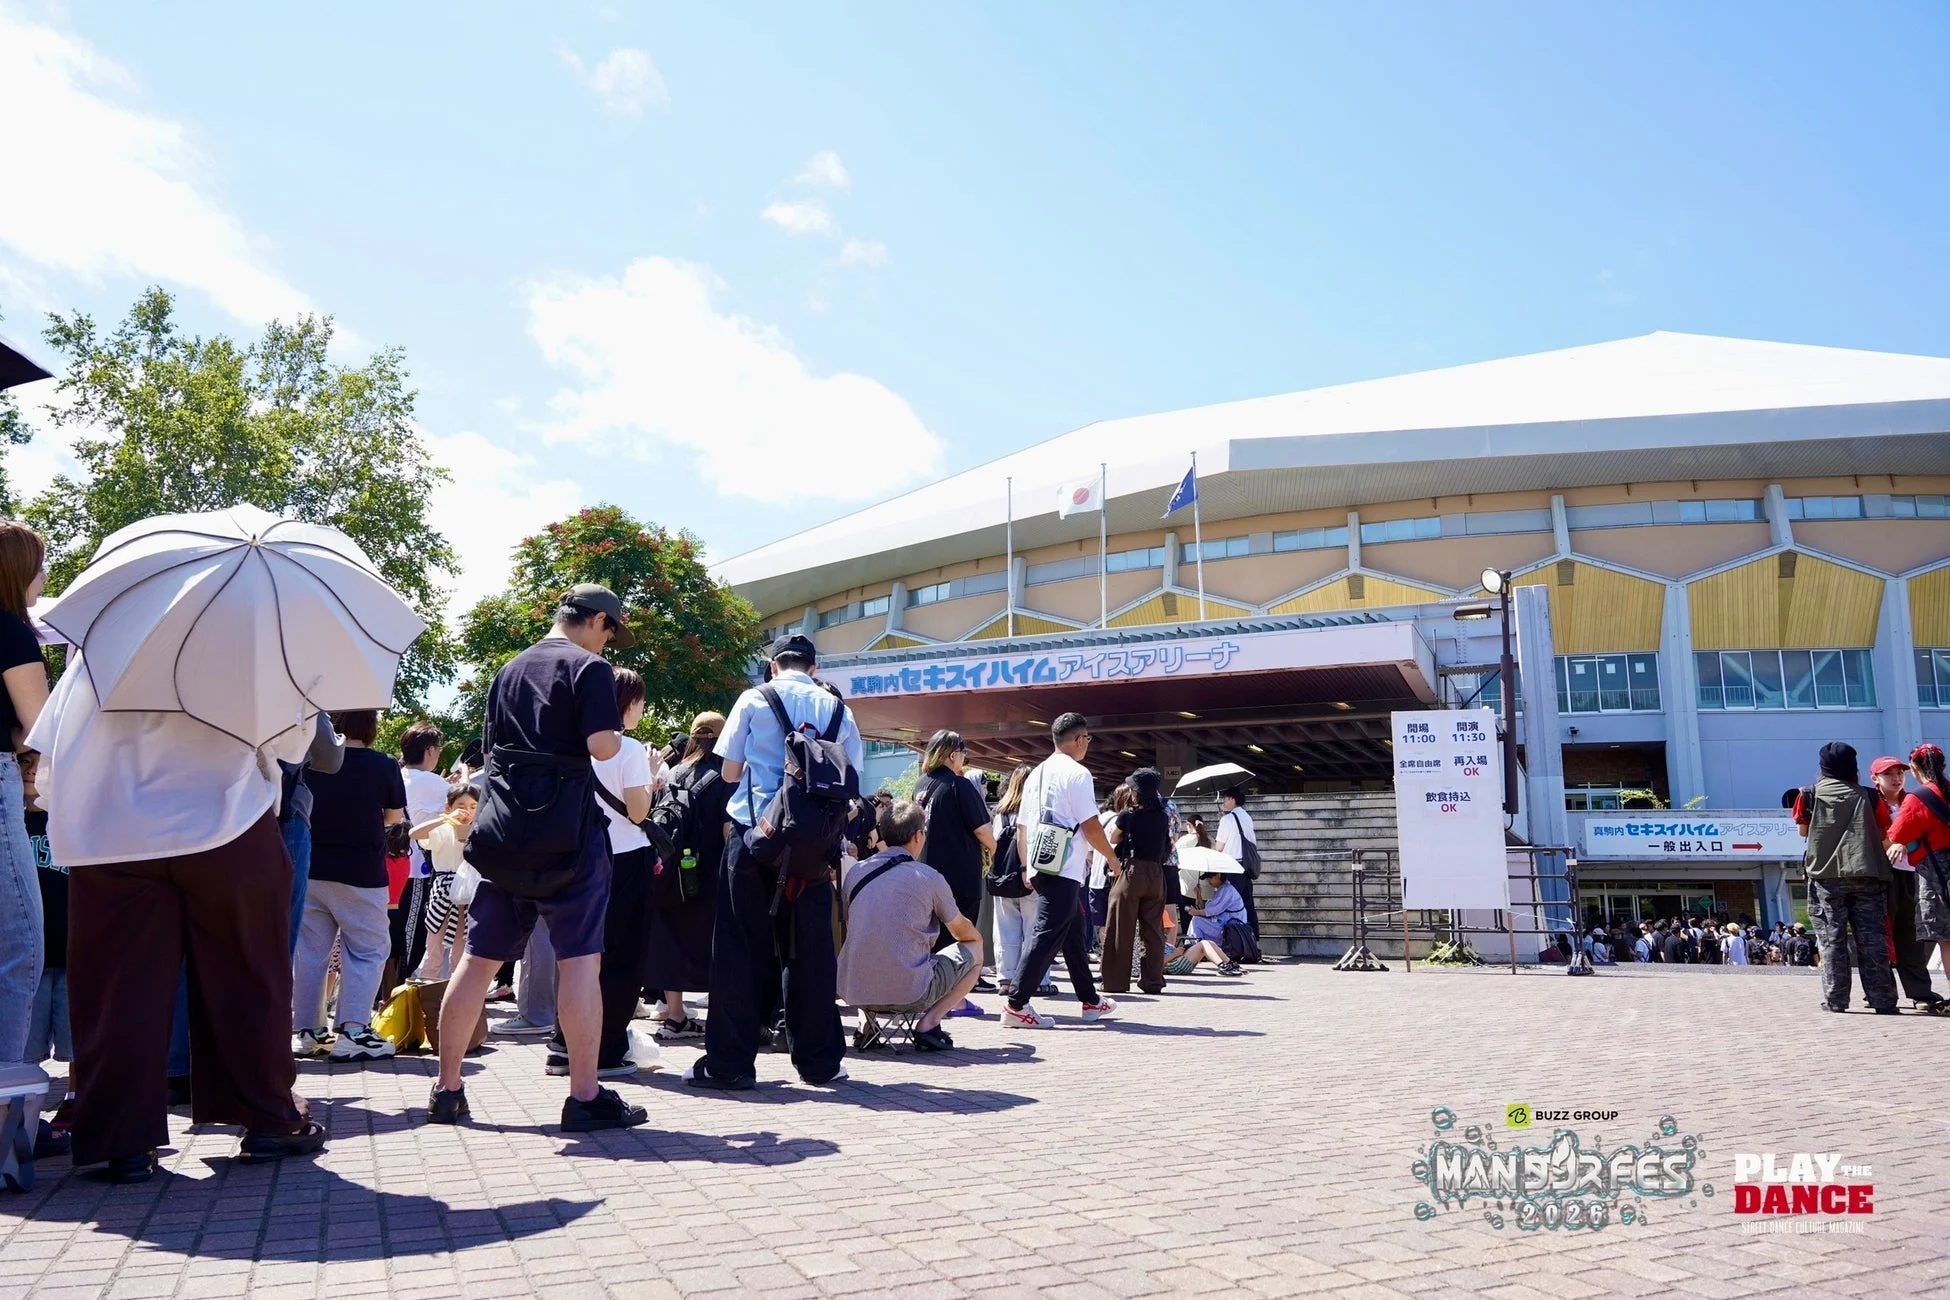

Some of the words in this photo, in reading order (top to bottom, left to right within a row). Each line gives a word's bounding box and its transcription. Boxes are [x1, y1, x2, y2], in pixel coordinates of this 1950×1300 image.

[850, 642, 1240, 695] 真駒内セキスイハイムアイスアリーナ
[1407, 723, 1429, 734] 開場
[1456, 721, 1479, 732] 開演
[1402, 734, 1436, 743] 11:00
[1452, 732, 1486, 742] 11:30
[1400, 759, 1441, 768] 全席自由席
[1454, 755, 1488, 766] 再入場
[1463, 767, 1480, 776] OK
[1425, 791, 1471, 802] 飲食持込
[1440, 803, 1457, 813] OK
[1593, 822, 1798, 837] 真駒内セキスイハイムアイスアリー
[1648, 840, 1723, 852] 一般出入口
